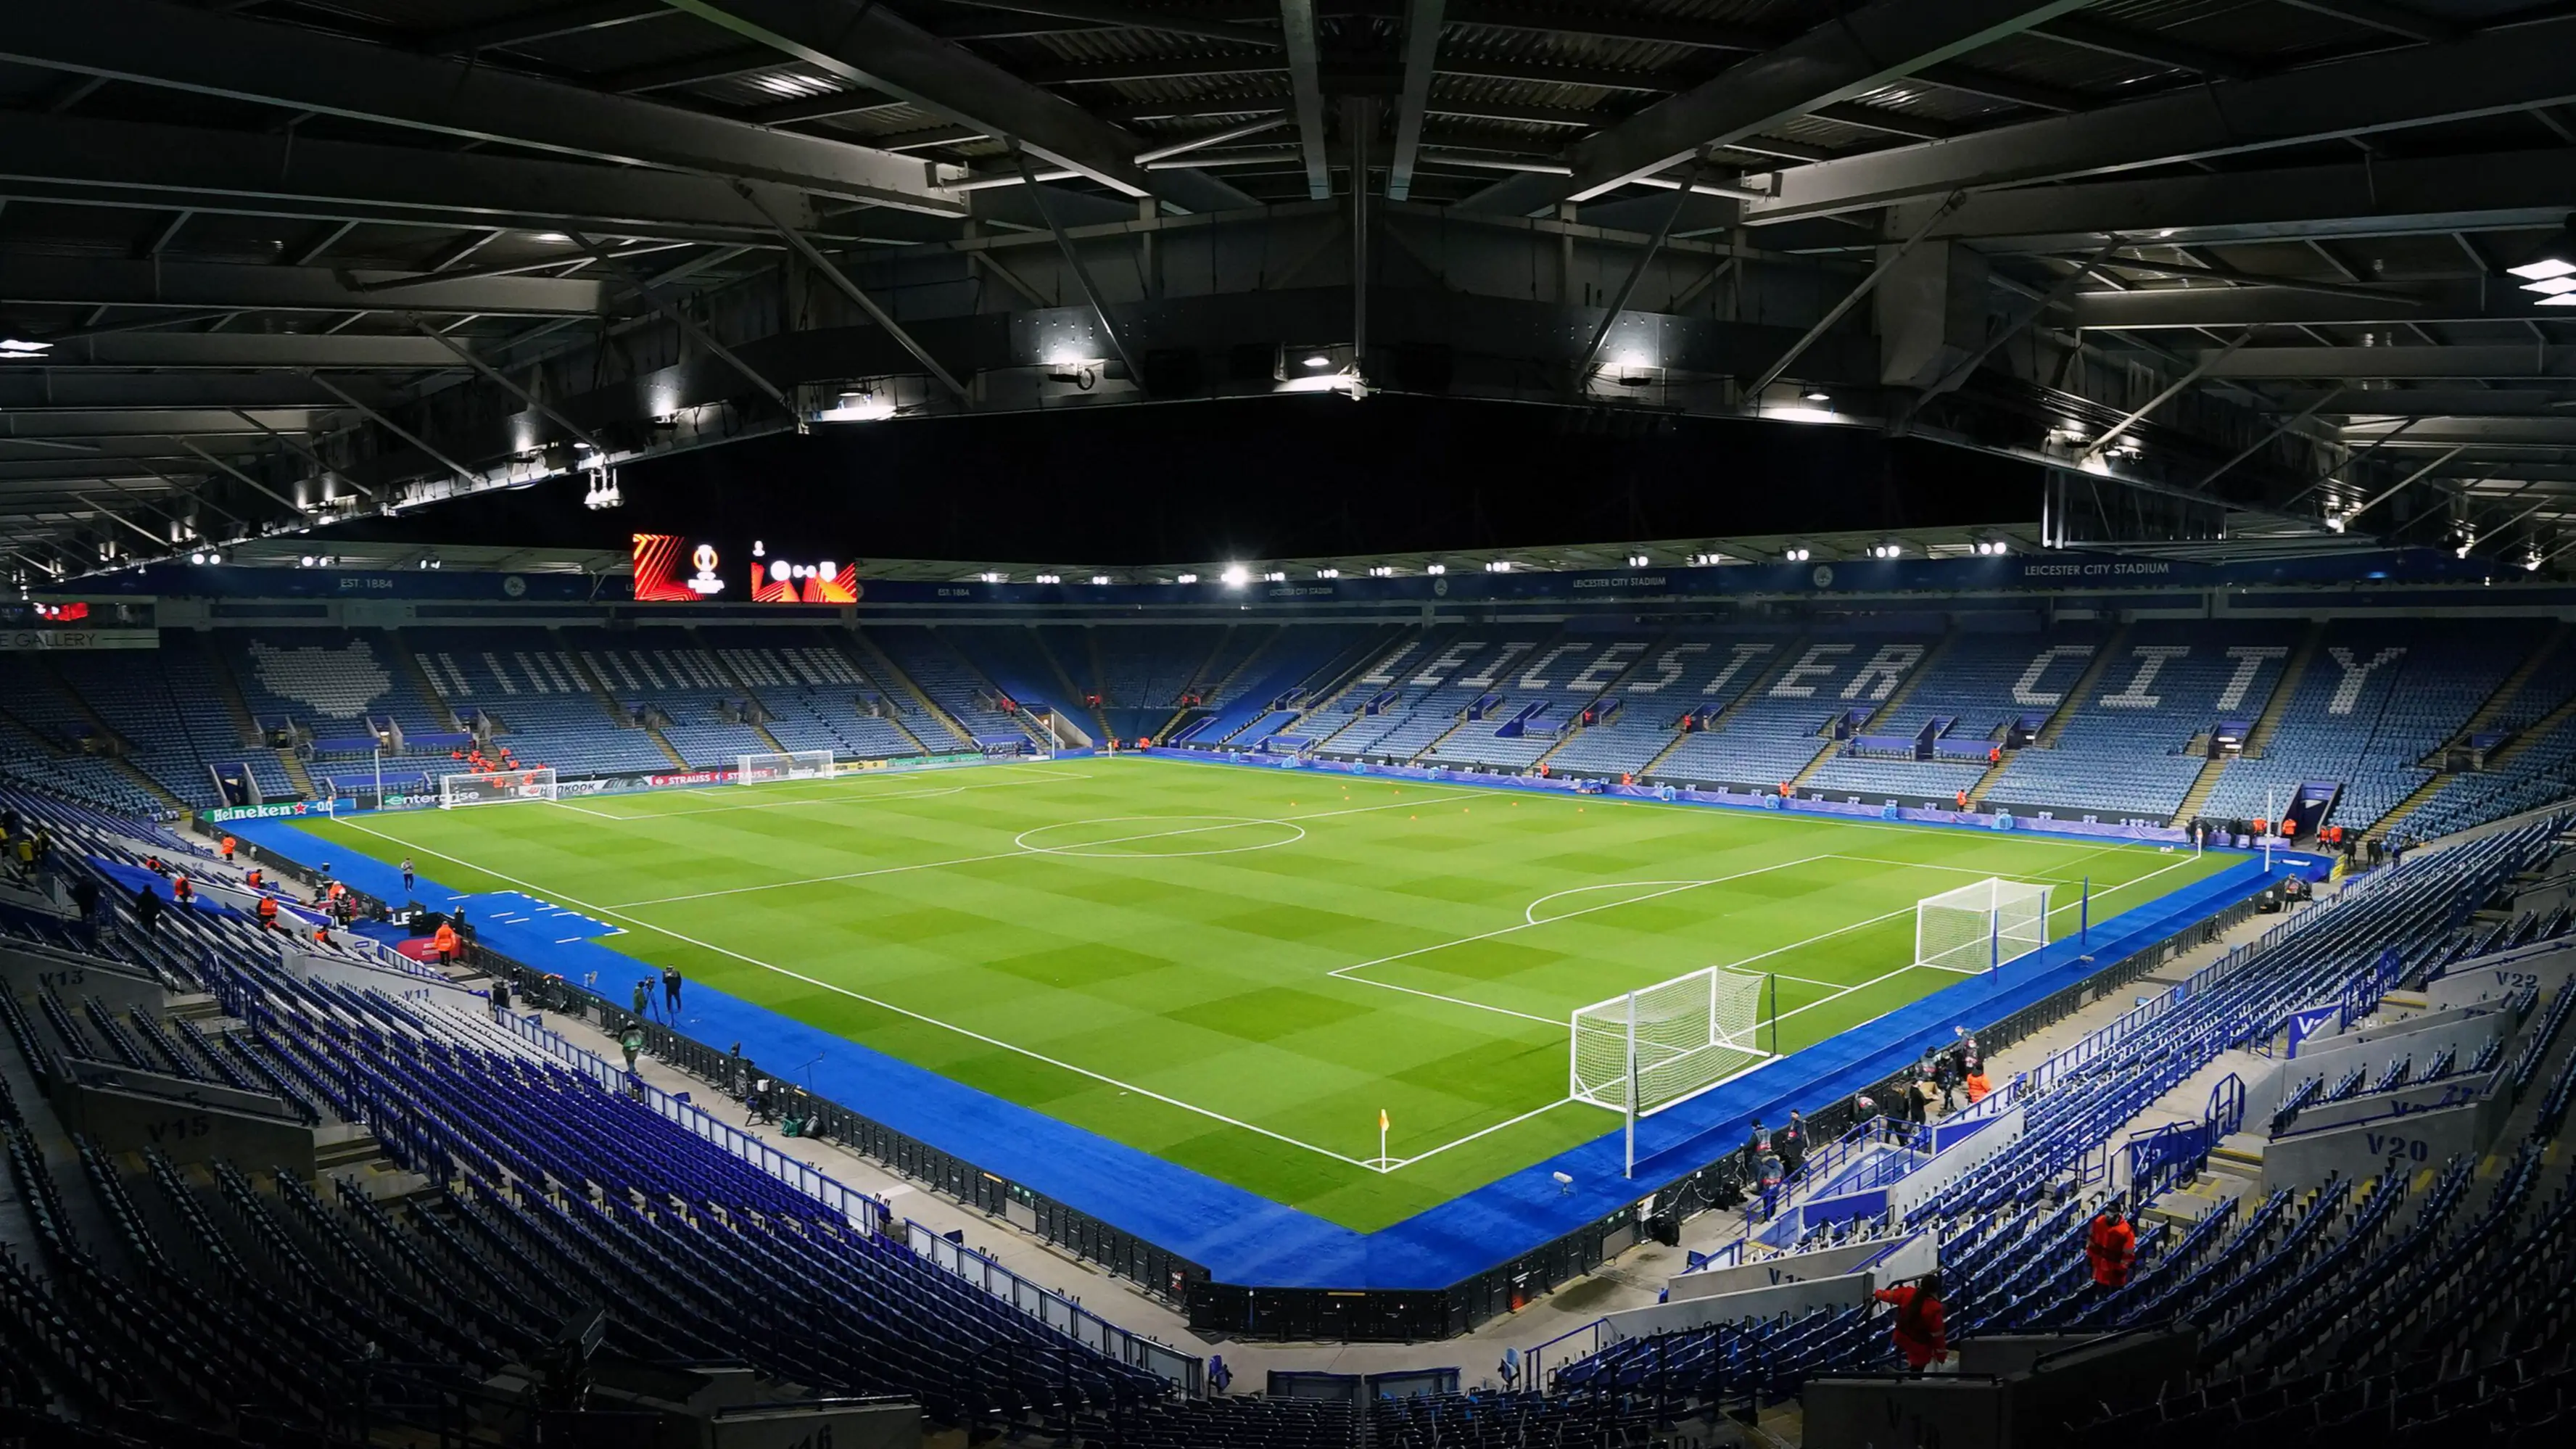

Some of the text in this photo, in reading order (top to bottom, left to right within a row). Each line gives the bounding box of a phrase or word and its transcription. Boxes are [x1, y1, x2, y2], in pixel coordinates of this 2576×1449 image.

[2025, 563, 2169, 576] LEICESTER CITY STADIUM
[340, 578, 393, 589] EST. 1884
[1573, 577, 1667, 588] LEICESTER CITY STADIUM
[15, 632, 96, 648] GALLERY
[1362, 641, 2408, 714] LEICESTER CITY
[669, 772, 711, 783] STRAUSS
[213, 804, 292, 822] Heineken
[38, 971, 84, 987] V13
[2496, 971, 2538, 988] V22
[405, 988, 429, 1001] V11
[147, 1117, 210, 1142] V15
[2366, 1132, 2428, 1162] V20
[1768, 1267, 1807, 1285] V1
